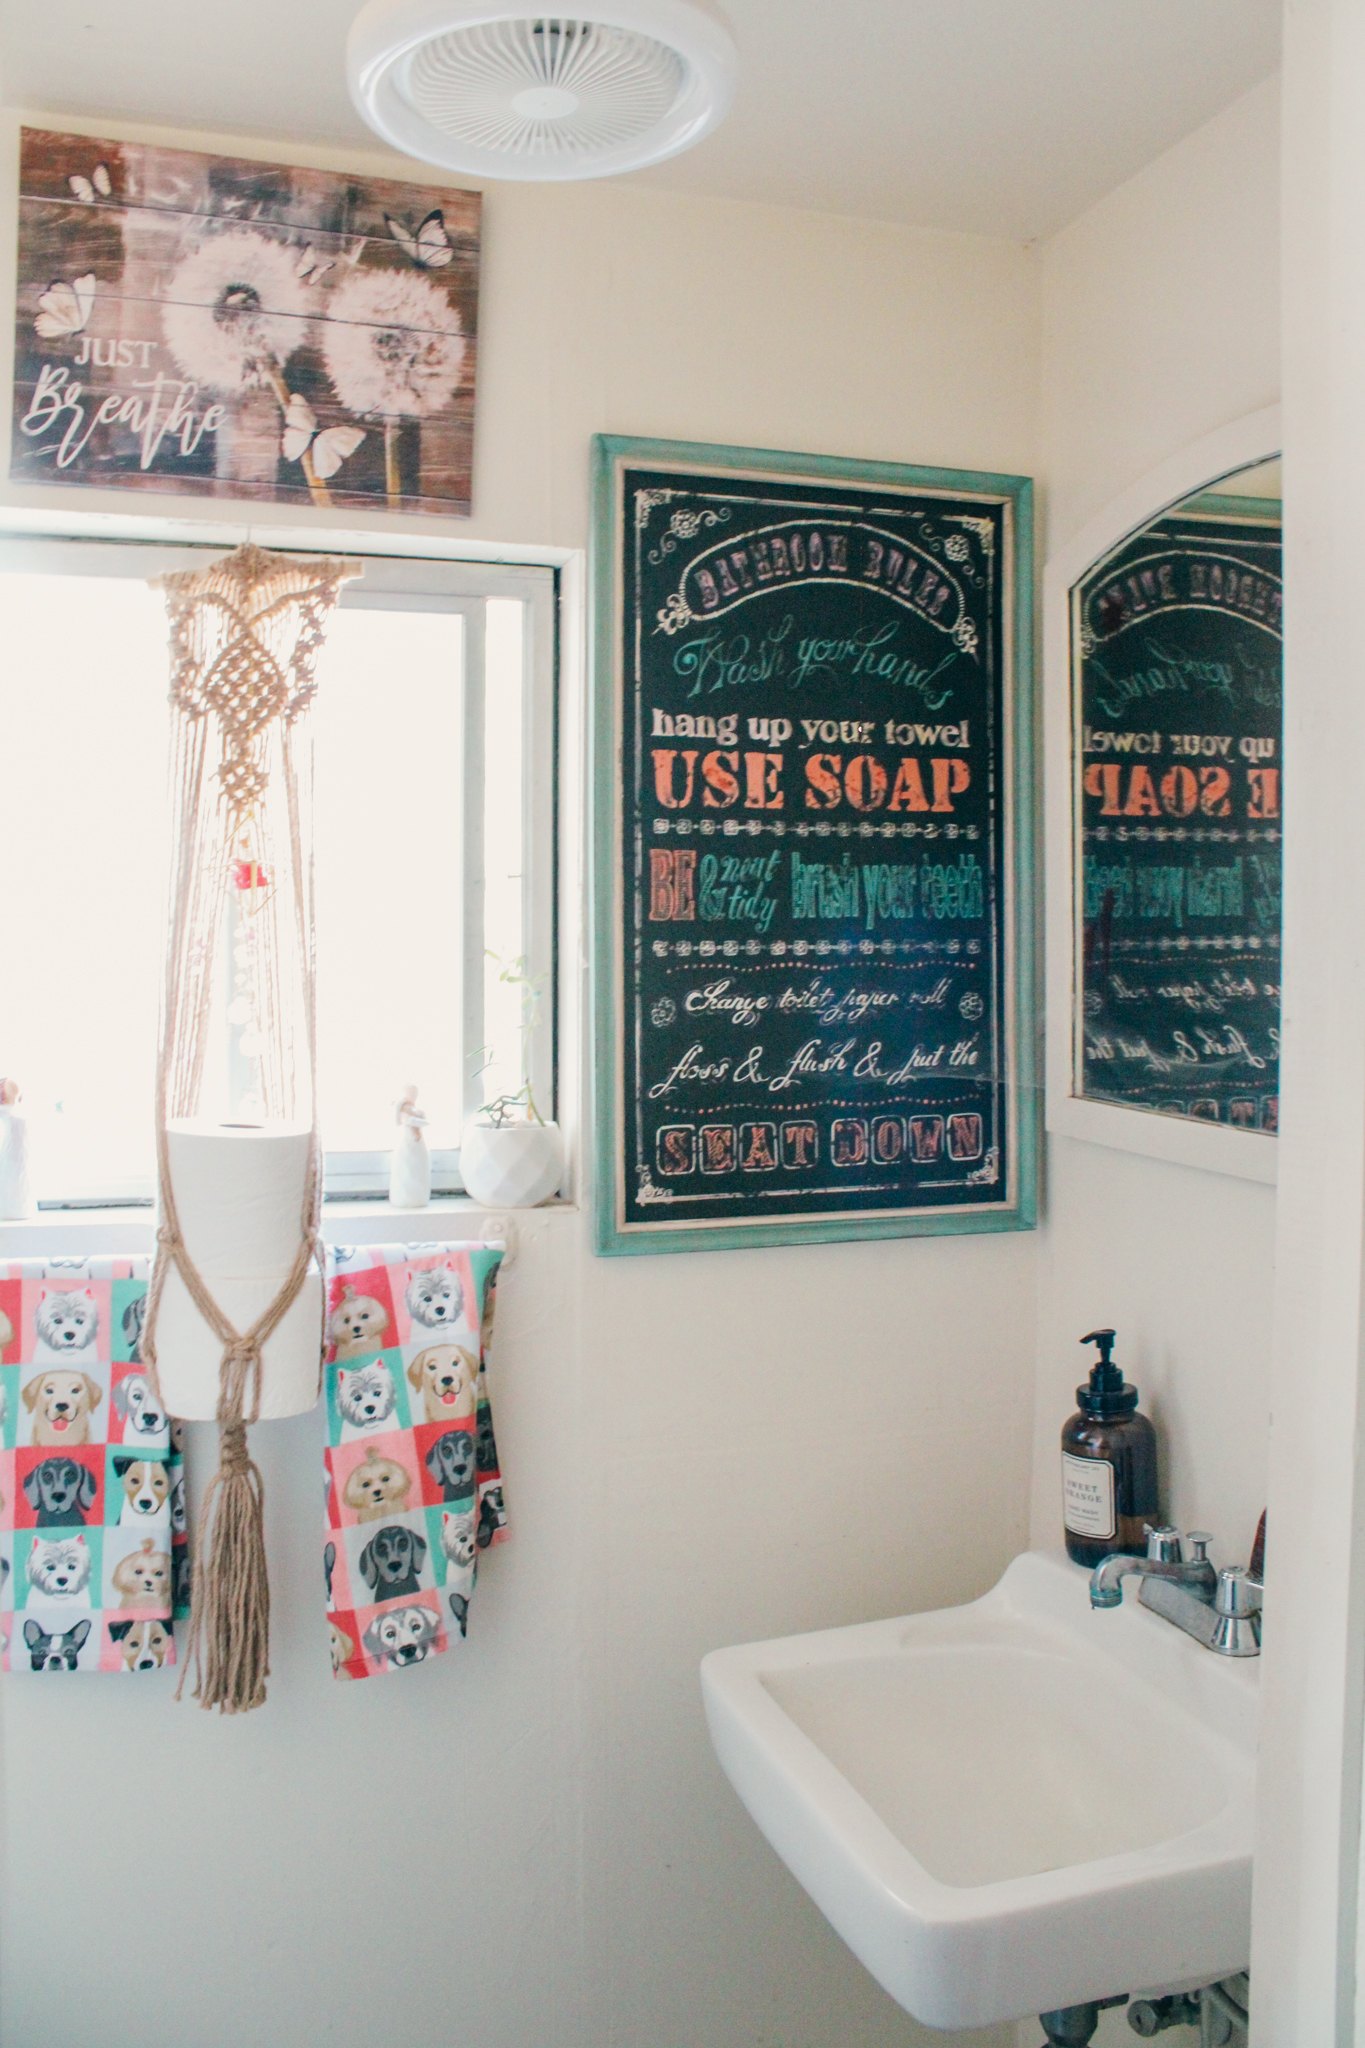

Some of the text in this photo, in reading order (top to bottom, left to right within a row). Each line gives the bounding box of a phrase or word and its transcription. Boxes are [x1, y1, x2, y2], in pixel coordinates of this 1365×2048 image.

[74, 336, 158, 369] JUST
[20, 363, 229, 470] Breathe
[694, 531, 950, 616] BATHROOM RULES
[673, 614, 959, 711] Wash your hands
[651, 708, 970, 748] hang up your towel
[651, 749, 970, 812] USE SOAP
[650, 848, 697, 921] BE
[719, 850, 781, 883] neat
[791, 851, 859, 919] brush
[863, 863, 917, 930] your
[921, 852, 984, 919] teeth
[728, 881, 781, 933] tidy
[778, 976, 835, 1013] toilet
[820, 986, 899, 1025] paper
[649, 1030, 982, 1099] floss & flush & put the
[663, 1115, 980, 1173] SEAT DOWN
